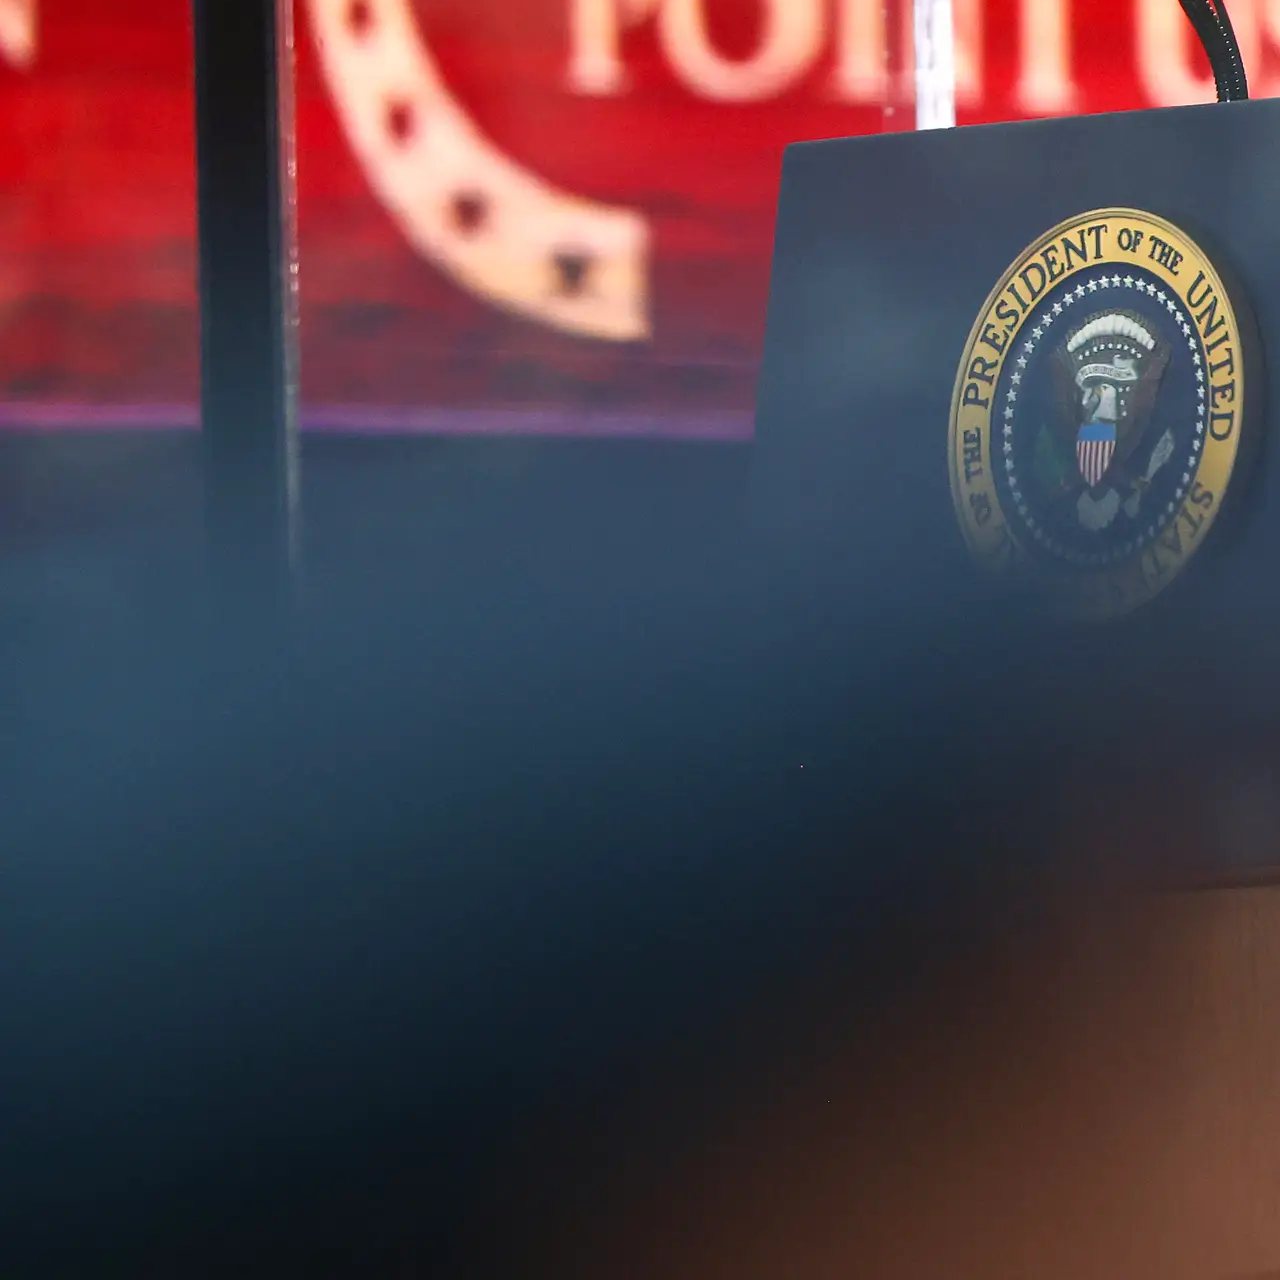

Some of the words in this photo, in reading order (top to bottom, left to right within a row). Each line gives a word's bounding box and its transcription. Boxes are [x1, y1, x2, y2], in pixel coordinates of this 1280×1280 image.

[1118, 228, 1143, 253] OF
[1149, 235, 1184, 275] THE
[963, 224, 1107, 409] PRESIDENT
[1187, 271, 1234, 441] UNITED
[964, 426, 982, 484] THE
